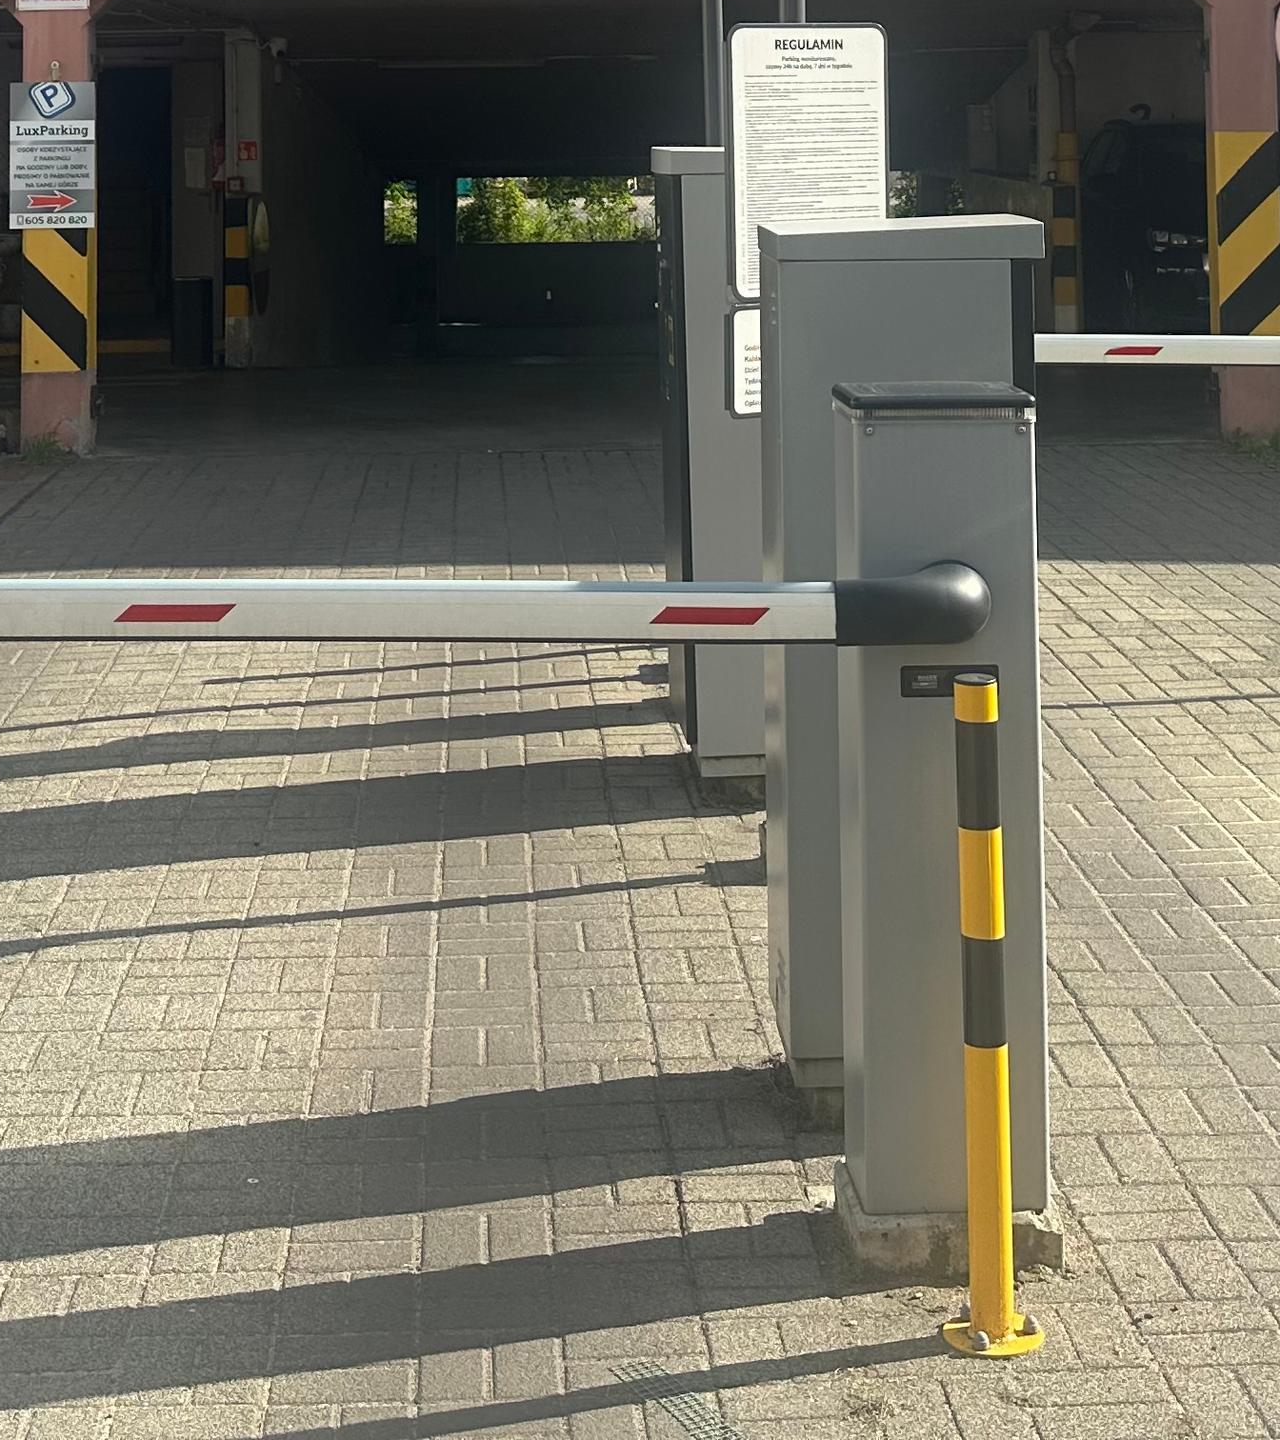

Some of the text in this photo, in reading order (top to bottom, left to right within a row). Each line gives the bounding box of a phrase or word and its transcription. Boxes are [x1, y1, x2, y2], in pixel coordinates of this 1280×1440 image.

[774, 39, 844, 50] REGULAMIN
[16, 125, 89, 137] LuxParking
[25, 216, 87, 224] 605 820 820
